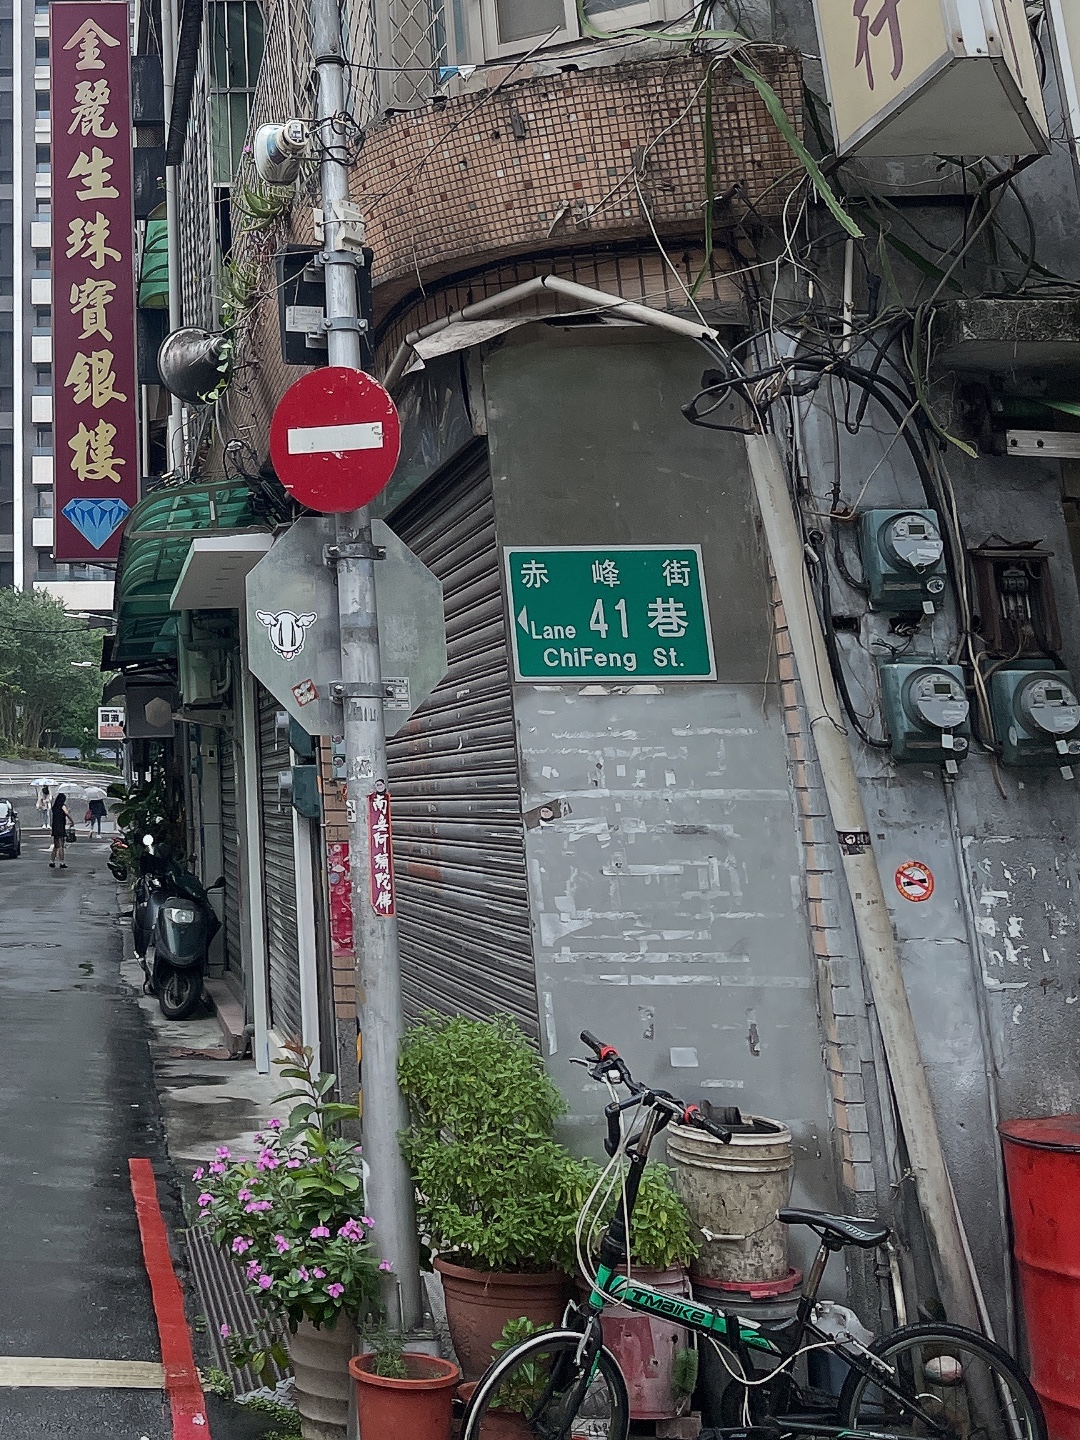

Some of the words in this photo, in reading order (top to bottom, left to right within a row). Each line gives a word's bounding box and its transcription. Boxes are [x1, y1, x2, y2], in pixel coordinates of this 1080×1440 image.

[62, 18, 127, 484] 金麗生珠寶銀樓
[520, 558, 691, 589] 赤峰街
[530, 620, 577, 640] Lane
[589, 598, 629, 639] 41
[647, 597, 689, 638] 巷
[543, 647, 637, 672] ChiFeng
[652, 647, 685, 667] St.
[372, 793, 392, 914] 南無阿彌陀佛
